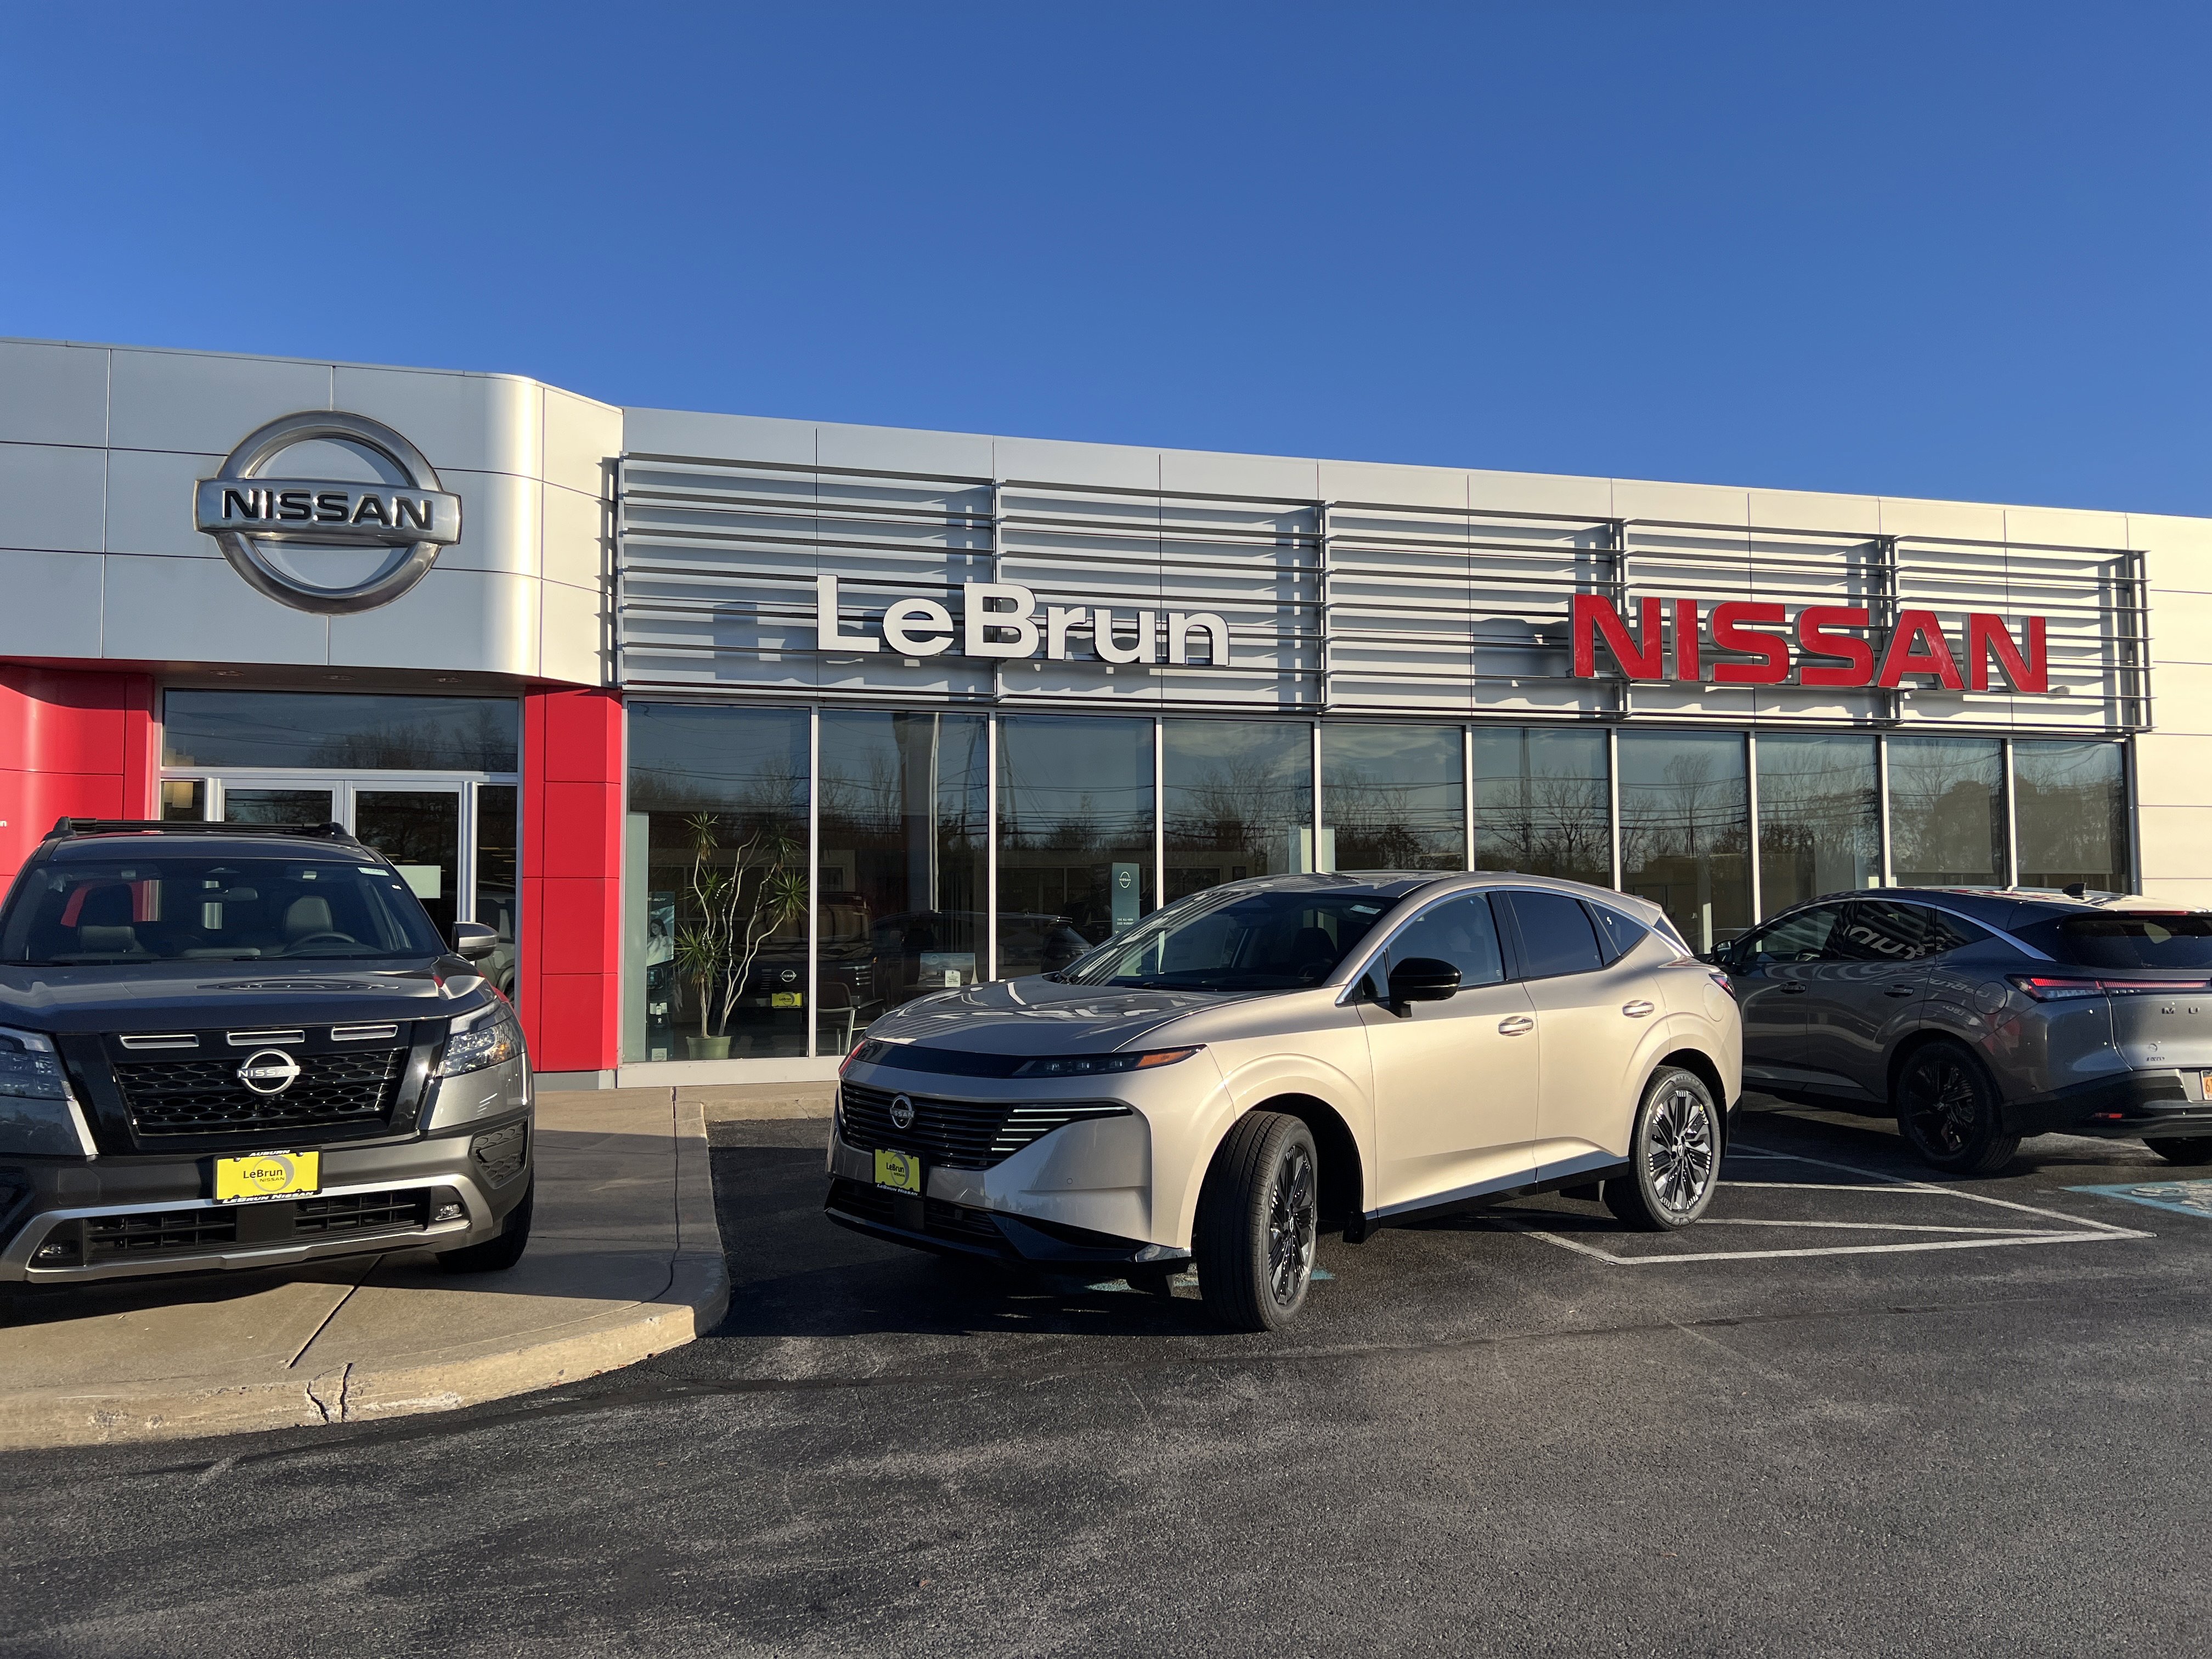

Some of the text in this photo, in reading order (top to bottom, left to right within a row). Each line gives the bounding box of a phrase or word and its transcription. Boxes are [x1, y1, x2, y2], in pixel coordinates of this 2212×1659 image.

[221, 488, 434, 531] NISSAN
[817, 574, 1230, 666] LeBrun
[1568, 594, 2049, 693] NISSAN
[238, 1068, 296, 1077] NISSAN
[243, 1169, 283, 1179] LeBrun
[887, 1163, 905, 1173] LeBrun
